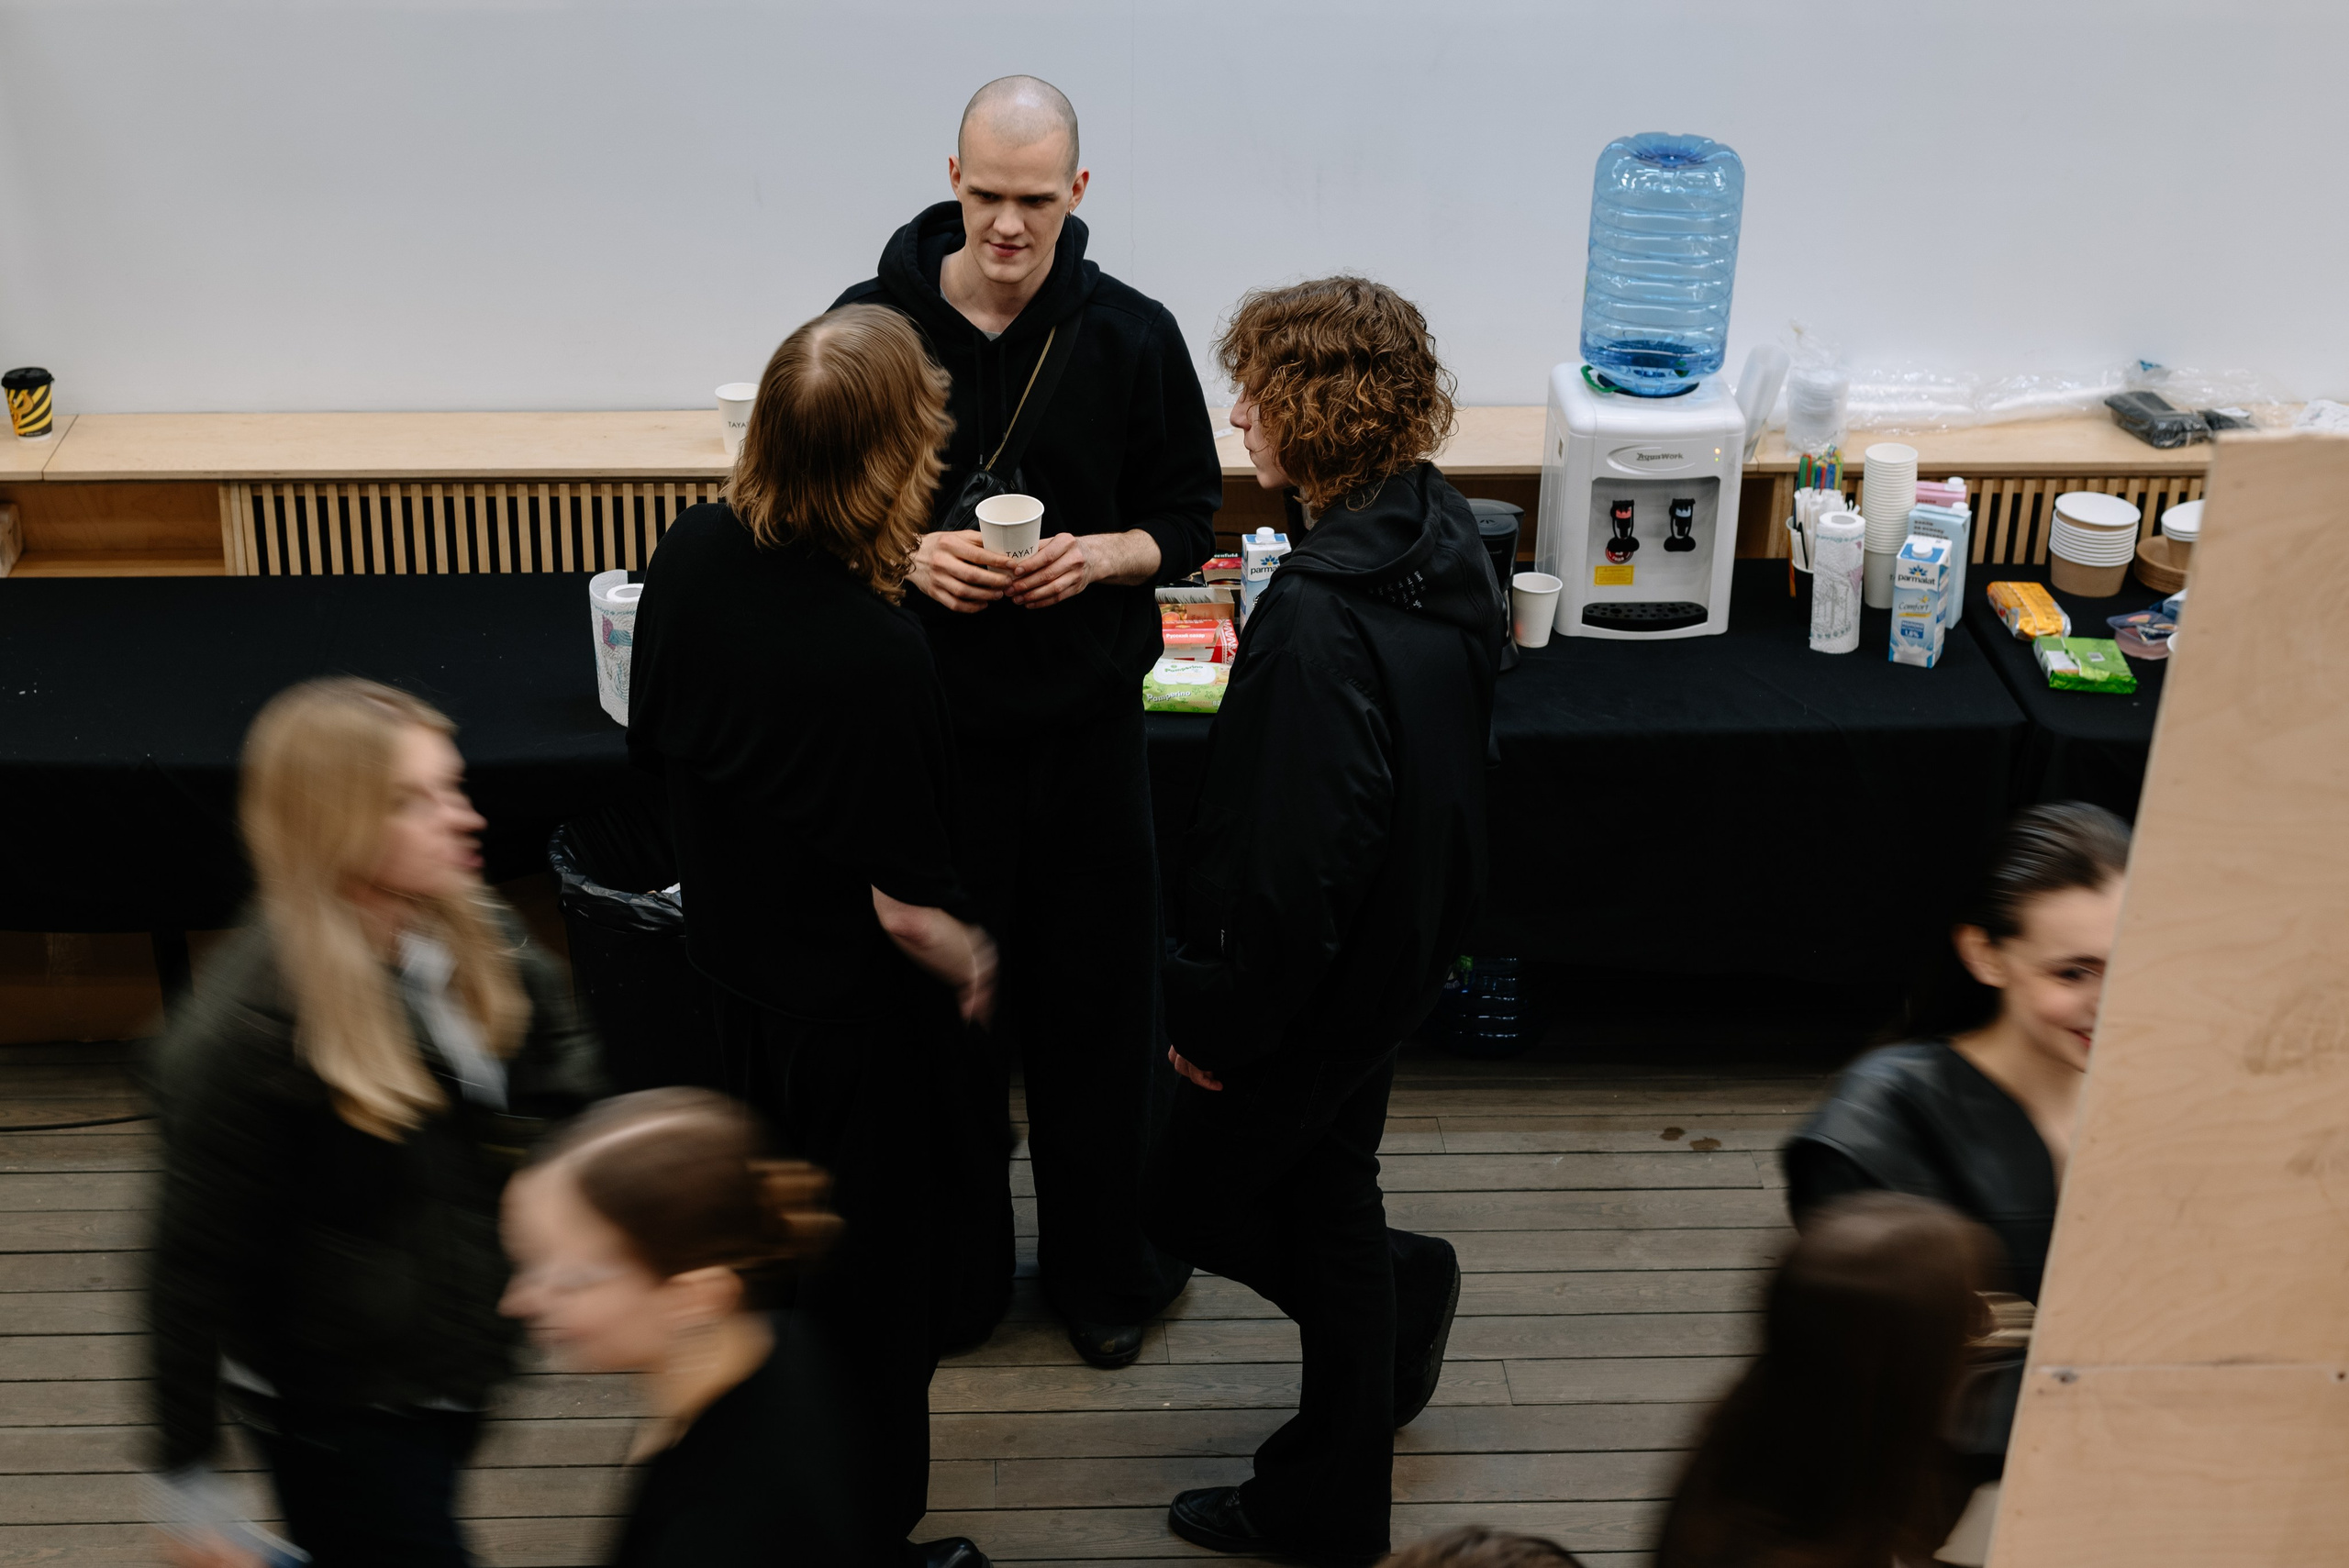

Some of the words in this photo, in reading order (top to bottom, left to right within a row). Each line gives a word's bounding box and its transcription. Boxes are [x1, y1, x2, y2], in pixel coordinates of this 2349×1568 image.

[1006, 546, 1035, 559] TAYAT
[1898, 573, 1935, 585] parmalat
[1898, 602, 1930, 611] Comfort
[1146, 691, 1191, 703] Pamperino
